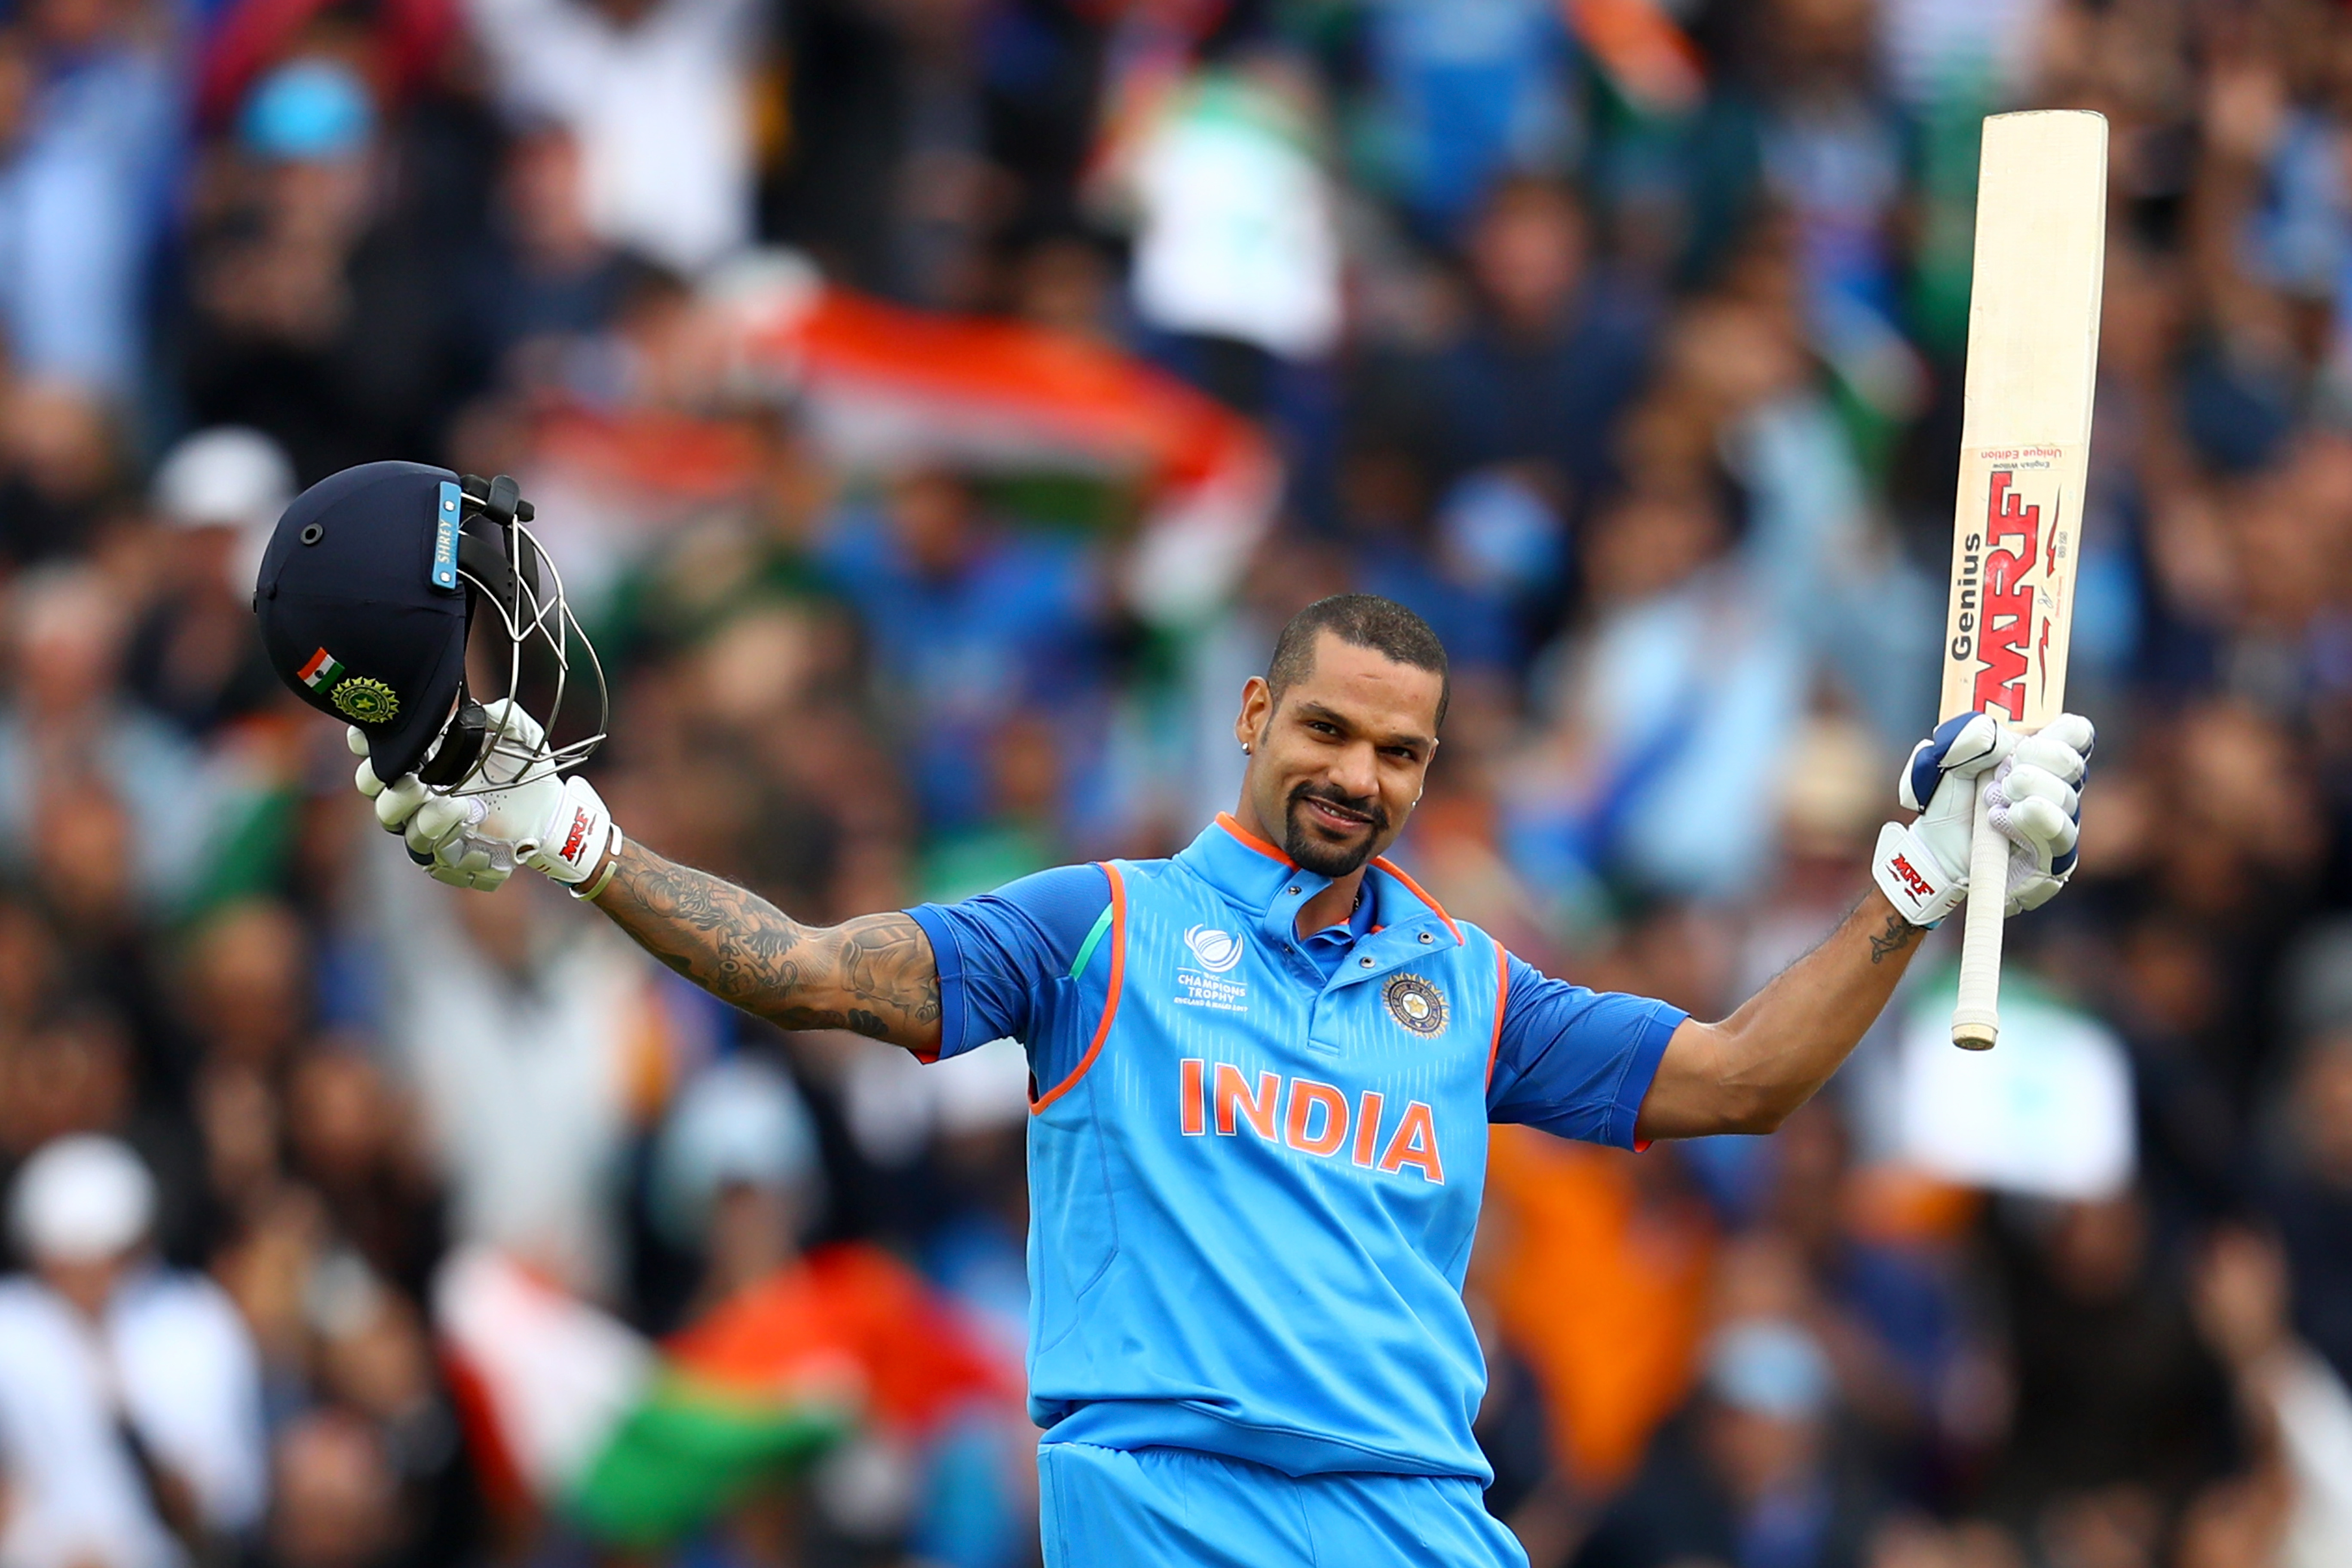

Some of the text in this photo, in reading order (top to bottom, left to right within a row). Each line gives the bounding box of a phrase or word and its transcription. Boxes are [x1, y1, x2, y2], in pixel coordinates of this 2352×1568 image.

[1981, 447, 2062, 460] Unique Edition
[437, 519, 453, 564] SHREY
[1951, 533, 1980, 661] Genius
[1973, 471, 2040, 721] MRF
[559, 806, 588, 862] MRF
[1891, 852, 1935, 895] MRF
[1174, 997, 1204, 1006] ENGLAND
[1178, 974, 1246, 997] CHAMPIONS
[1188, 986, 1234, 1003] TROPHY
[1180, 1058, 1445, 1185] INDIA
